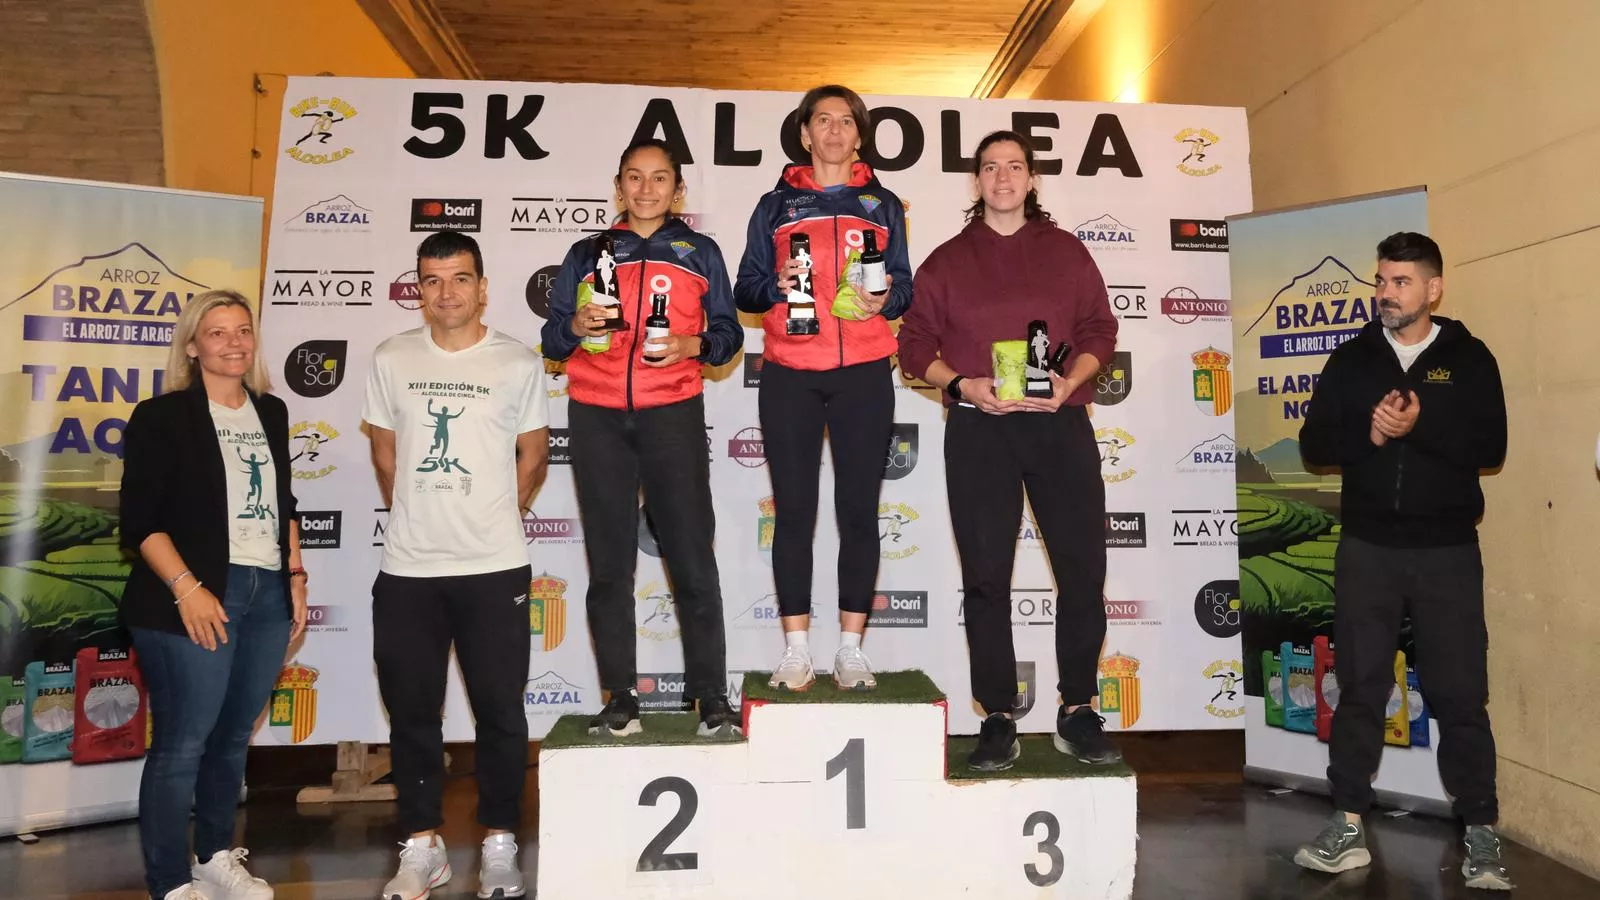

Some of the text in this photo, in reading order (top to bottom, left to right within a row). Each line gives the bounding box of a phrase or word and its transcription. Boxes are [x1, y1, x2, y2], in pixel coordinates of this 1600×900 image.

[403, 92, 550, 160] 5K
[285, 146, 354, 164] ALCOLEA
[445, 203, 475, 217] barri
[511, 207, 607, 225] MAYOR
[305, 213, 370, 224] BRAZAL
[1077, 231, 1135, 243] BRAZAL
[1200, 224, 1227, 237] barri
[100, 268, 160, 285] ARROZ
[272, 280, 373, 297] MAYOR
[1306, 280, 1349, 297] ARROZ
[53, 284, 193, 317] BRAZA
[1171, 302, 1228, 312] ANTONIO
[62, 322, 177, 343] EL ARROZ DE ARAG
[1283, 338, 1294, 353] EL
[1296, 336, 1324, 353] ARROZ
[1326, 335, 1337, 350] DE
[297, 349, 326, 365] Flor
[304, 359, 337, 386] Sal
[408, 382, 490, 395] XIII EDICIÓN 5K
[1258, 376, 1278, 395] EL
[1194, 452, 1236, 463] BRAZ
[416, 457, 472, 475] 5K
[301, 516, 334, 530] barri
[524, 522, 569, 533] TONIO
[1110, 517, 1139, 531] barri
[891, 596, 920, 610] barri
[1204, 589, 1229, 605] Flor
[1105, 604, 1137, 615] ONIO
[37, 686, 75, 697] BRAZA
[526, 692, 581, 704] RAZAL
[825, 738, 866, 830] 1
[635, 776, 699, 873] 2
[1022, 810, 1065, 888] 3
